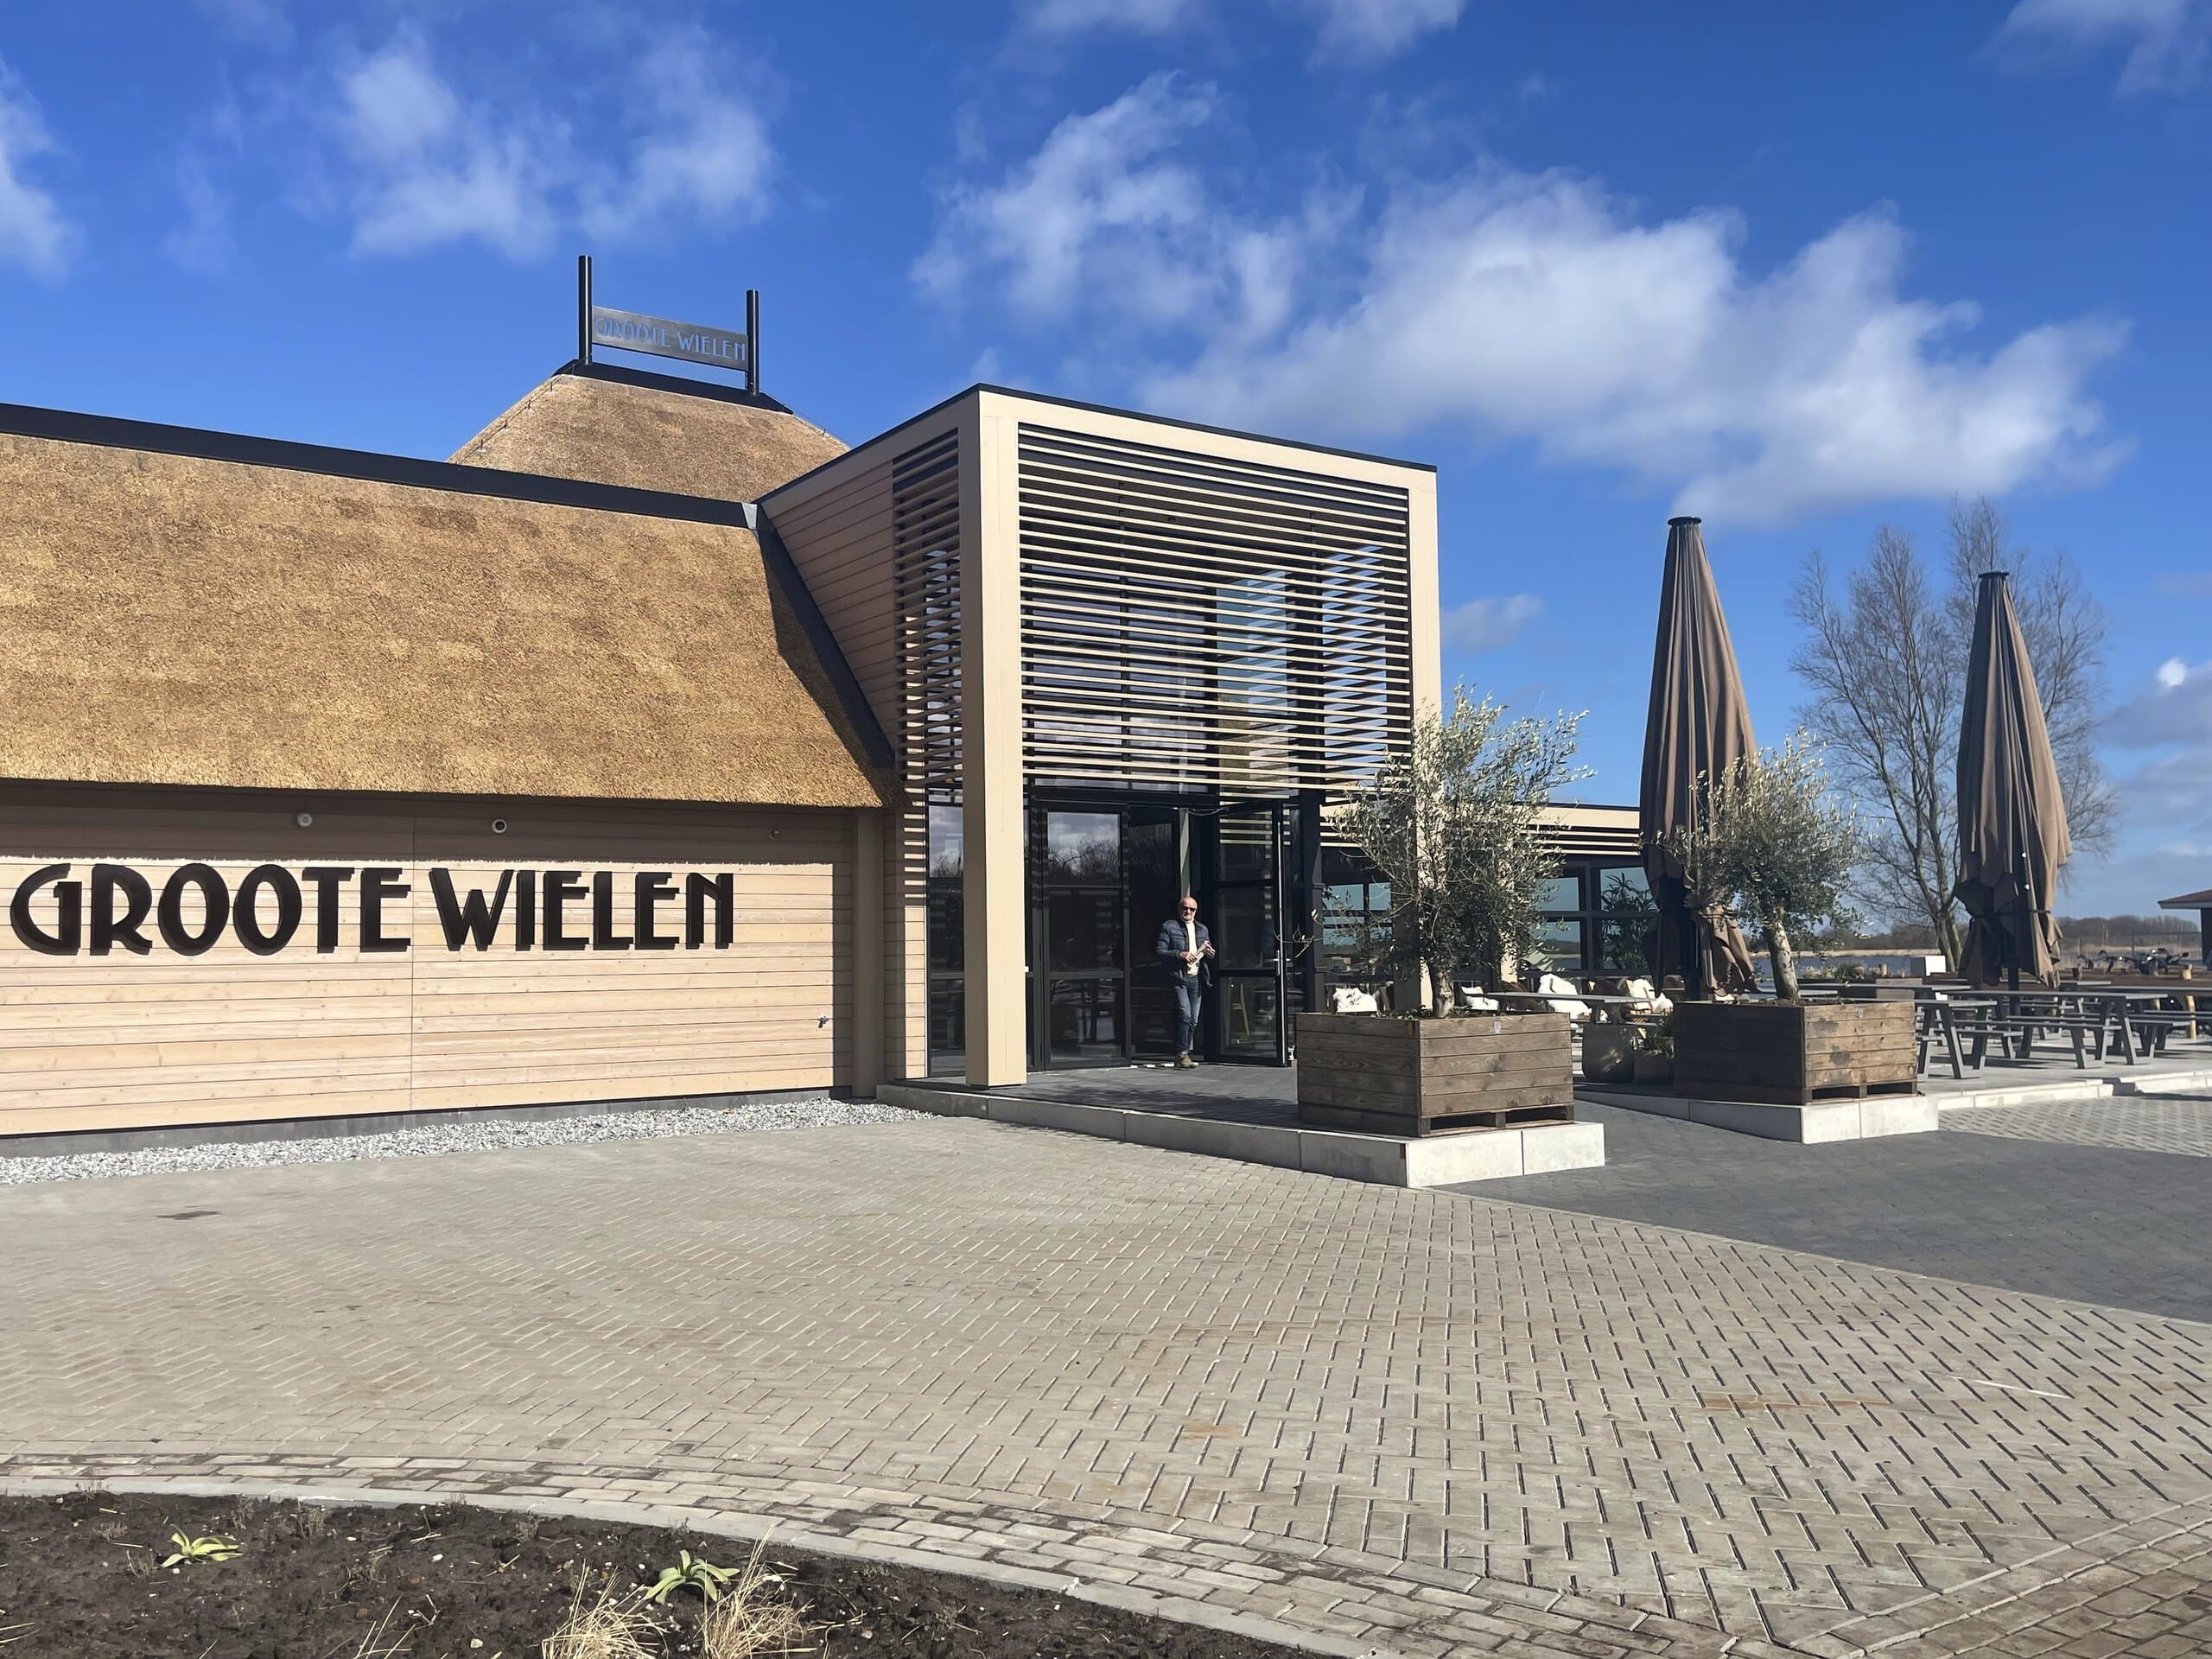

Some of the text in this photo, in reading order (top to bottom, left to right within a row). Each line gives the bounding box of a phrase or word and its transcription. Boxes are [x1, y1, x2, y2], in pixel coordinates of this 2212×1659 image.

[594, 317, 746, 361] GROOTE WIELEN
[10, 863, 734, 956] GROOTE WIELEN
